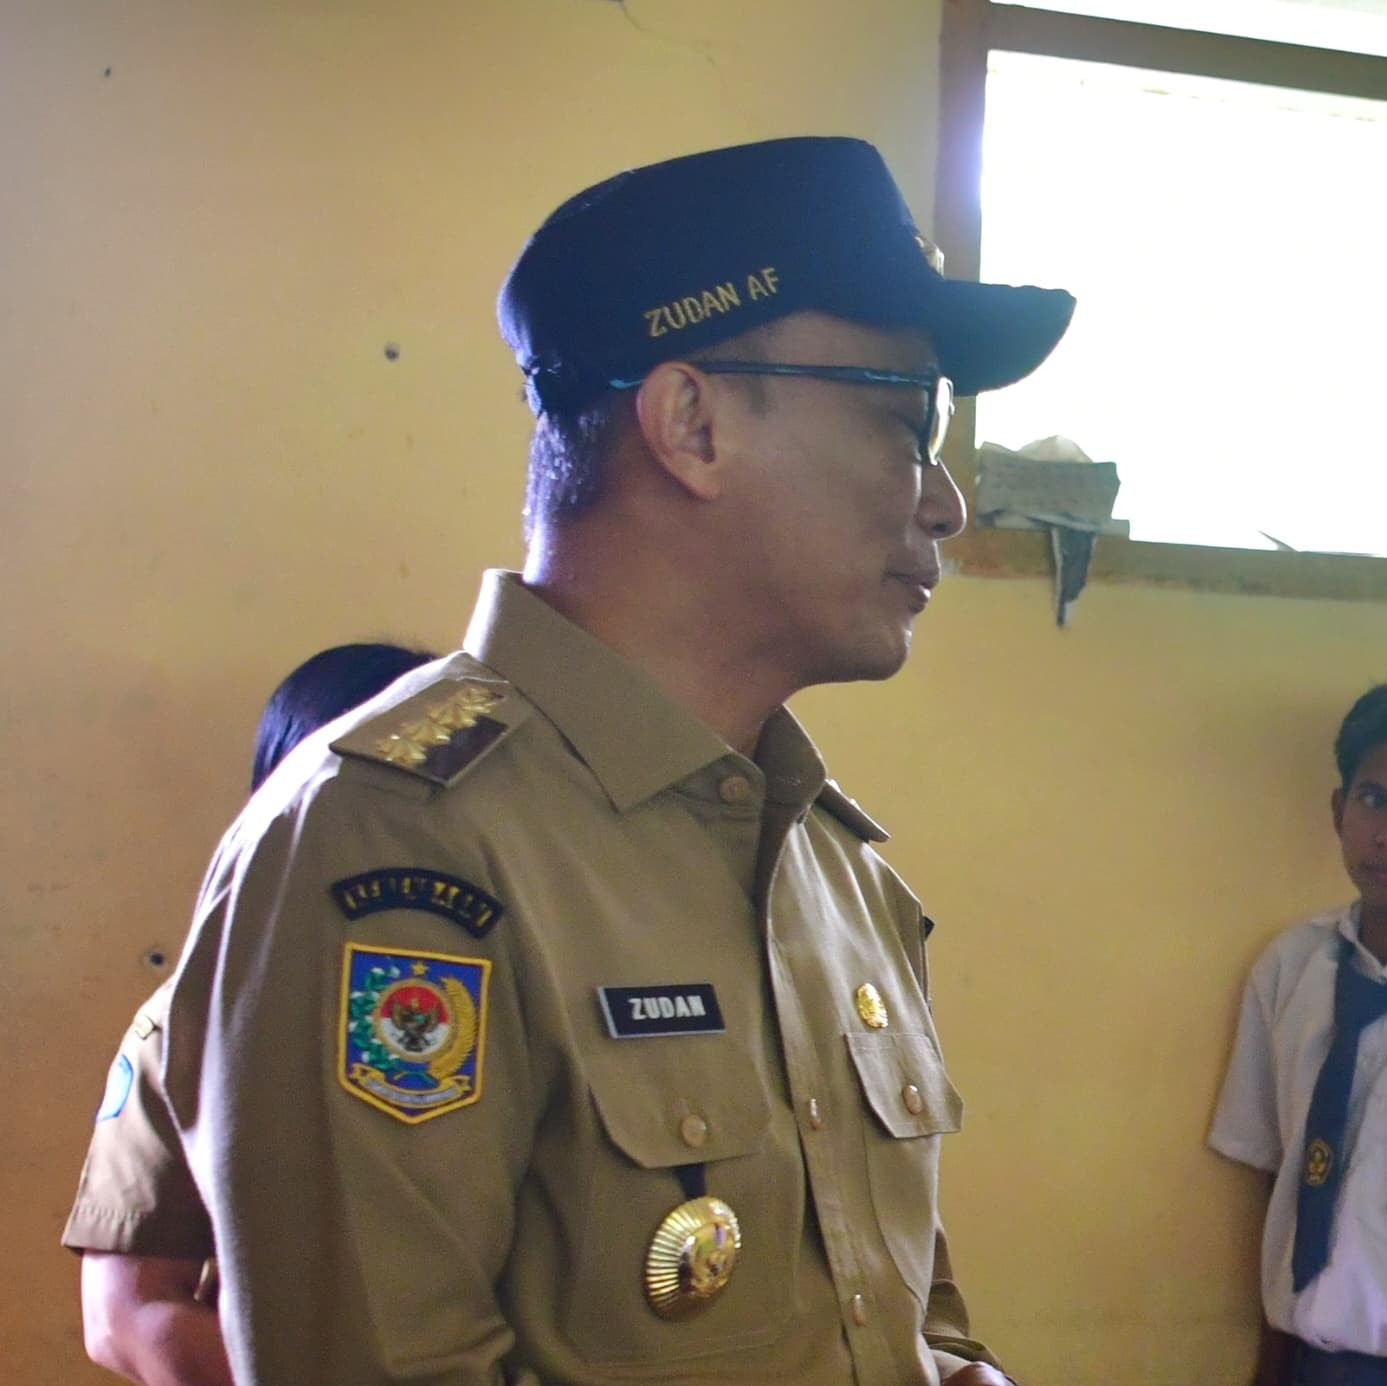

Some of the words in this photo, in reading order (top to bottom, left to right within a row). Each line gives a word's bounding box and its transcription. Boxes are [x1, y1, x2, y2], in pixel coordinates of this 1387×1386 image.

[643, 281, 741, 337] ZUDAN
[747, 267, 779, 300] AF
[628, 995, 706, 1020] ZUDAN
